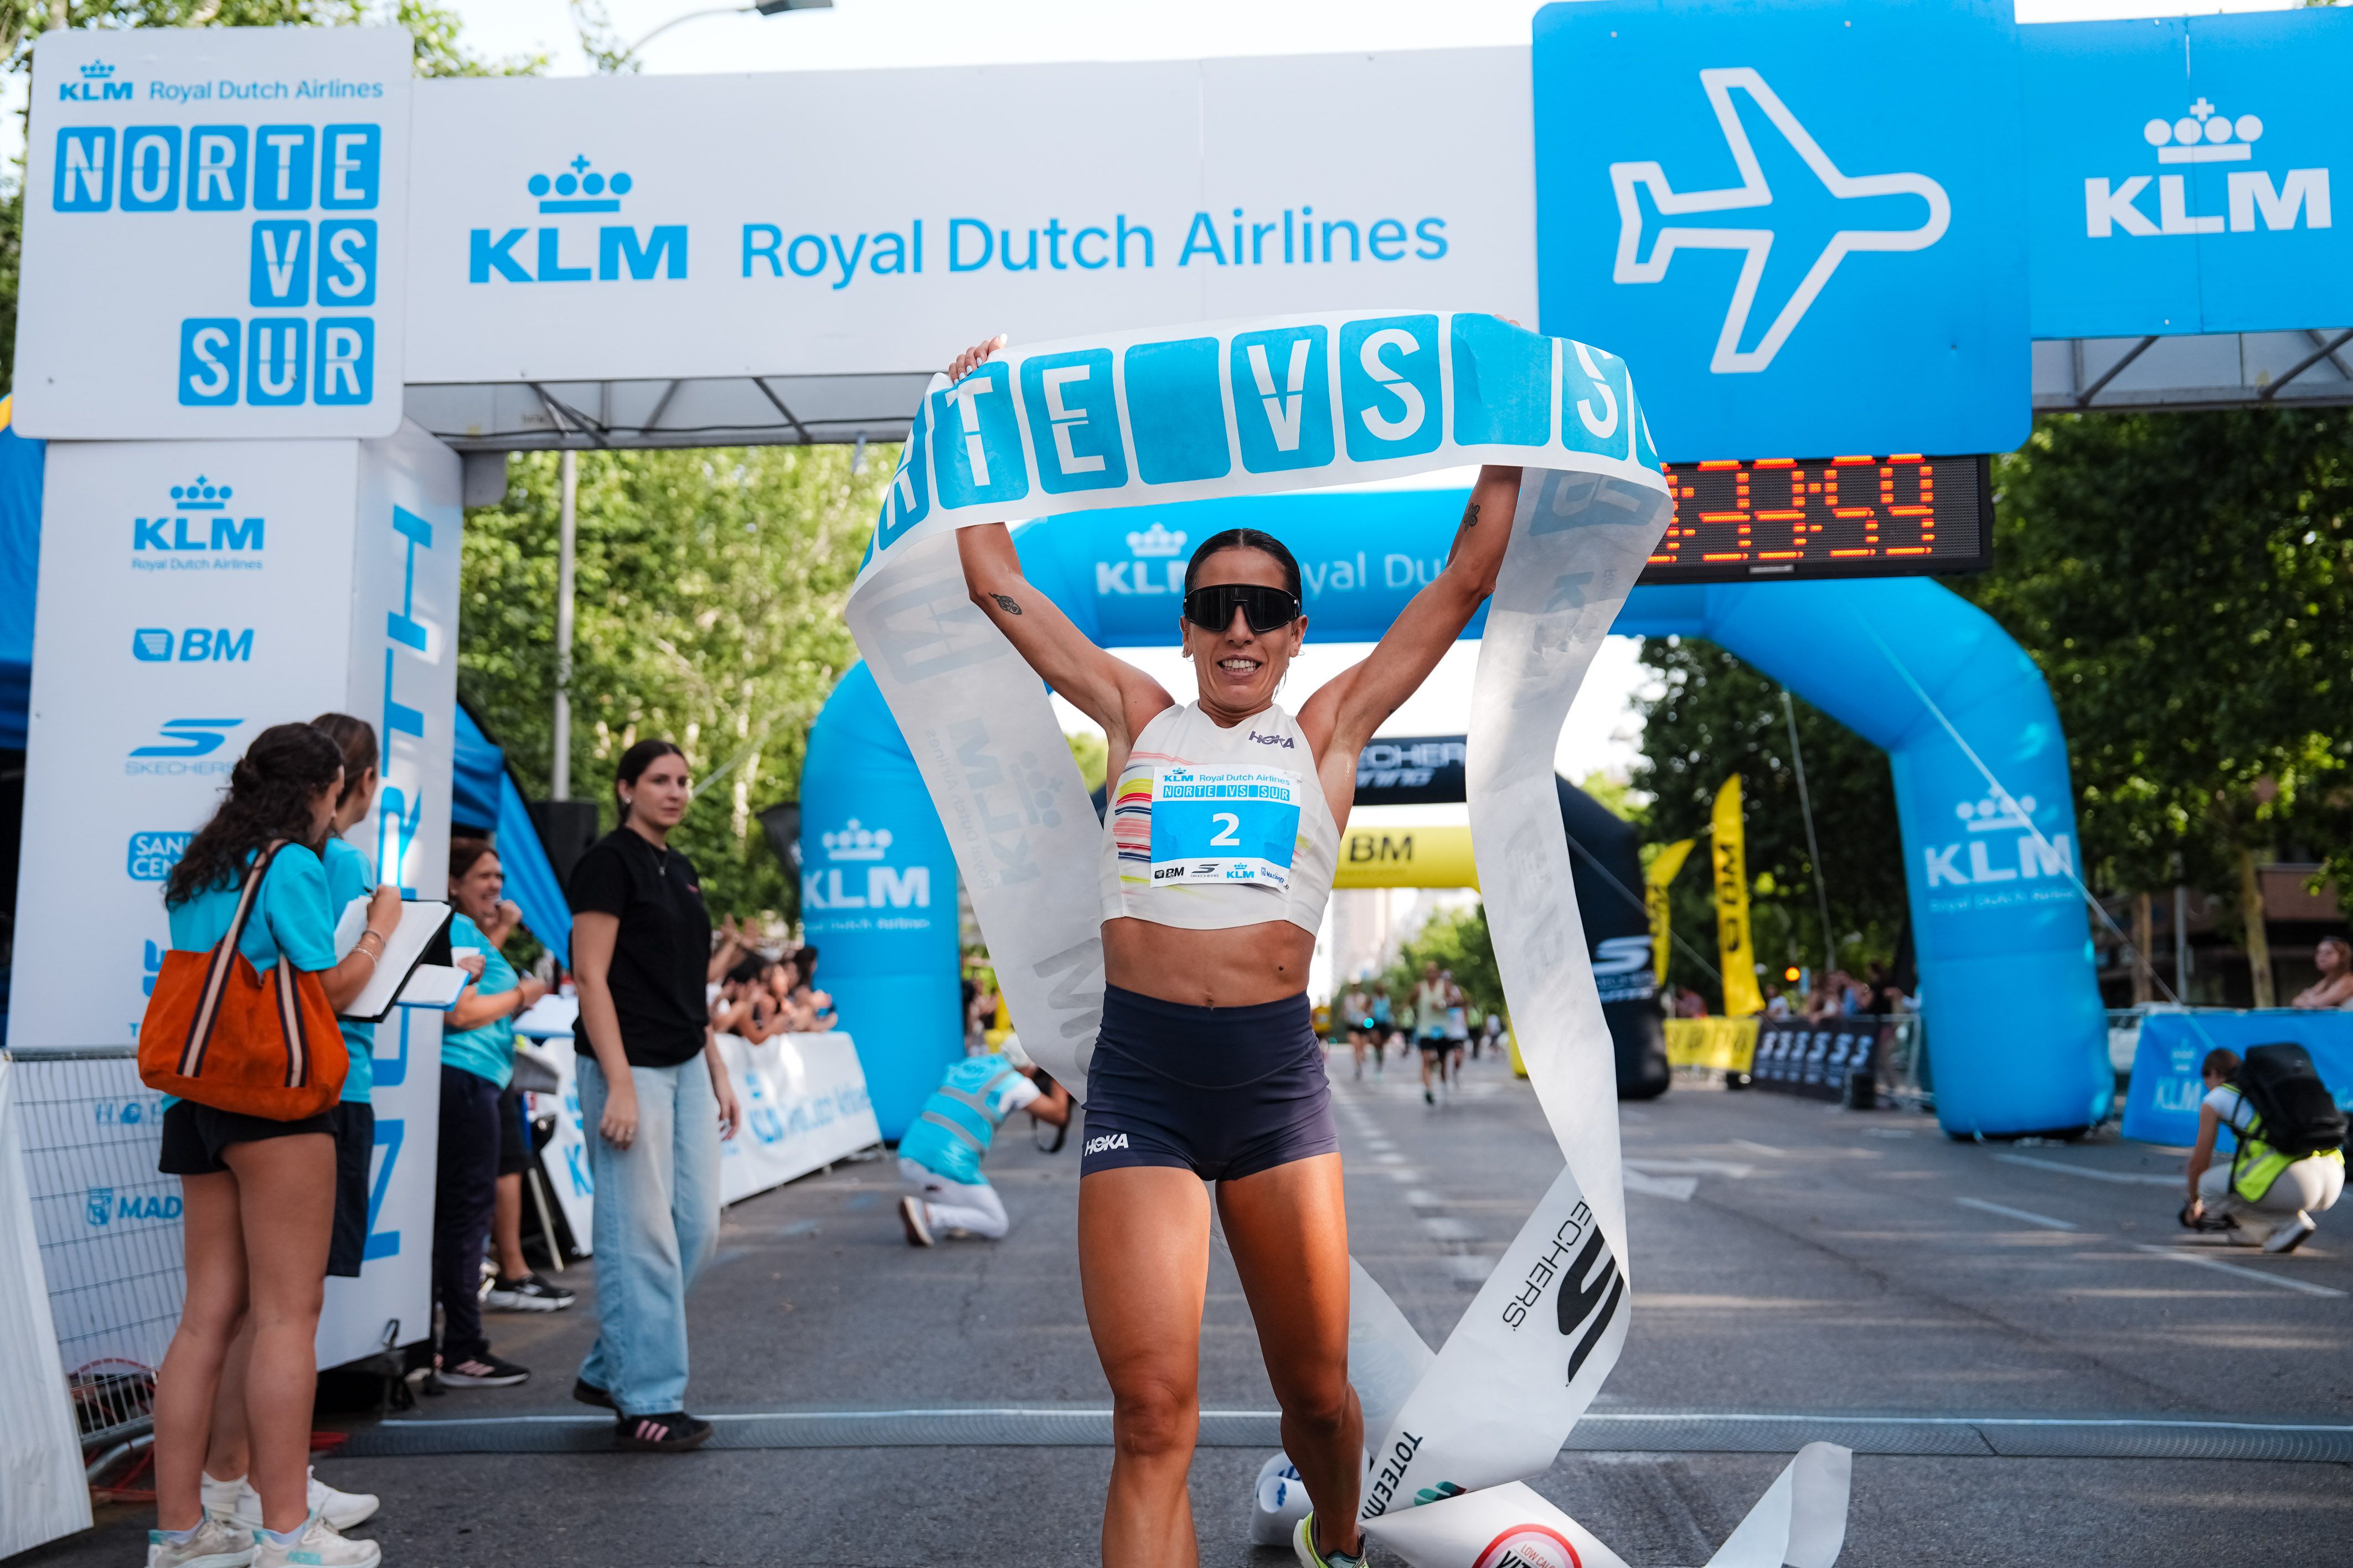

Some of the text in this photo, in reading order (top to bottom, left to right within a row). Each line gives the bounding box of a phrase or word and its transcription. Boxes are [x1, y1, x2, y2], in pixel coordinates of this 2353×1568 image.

[60, 81, 133, 101] KLM
[150, 77, 384, 105] Royal Dutch Airlines
[63, 133, 368, 203] NORTE
[2084, 168, 2332, 238] KLM
[261, 228, 367, 298] VS
[469, 224, 688, 283] KLM
[742, 205, 1449, 290] Royal Dutch Airlines
[189, 327, 363, 397] SUR
[886, 364, 1106, 530] RTE
[1247, 328, 1426, 452] VS
[134, 518, 265, 550] KLM
[132, 557, 263, 572] Royal Dutch Airlines
[1301, 550, 1366, 601] yal
[179, 628, 254, 661] BM
[1248, 731, 1294, 748] HOKA
[1164, 786, 1289, 800] NORTE VS SUR
[1199, 774, 1224, 783] Royal
[1256, 774, 1290, 785] Airlines
[1209, 812, 1241, 847] 2
[1349, 835, 1413, 863] BM
[1924, 834, 2073, 888] KLM
[802, 866, 931, 909] KLM
[1165, 867, 1185, 878] BM
[1226, 871, 1255, 879] KLM
[1084, 1133, 1129, 1157] HOKA
[118, 1196, 183, 1219] MAD
[1503, 1197, 1593, 1329] ECHERS
[1520, 1543, 1539, 1561] LOW
